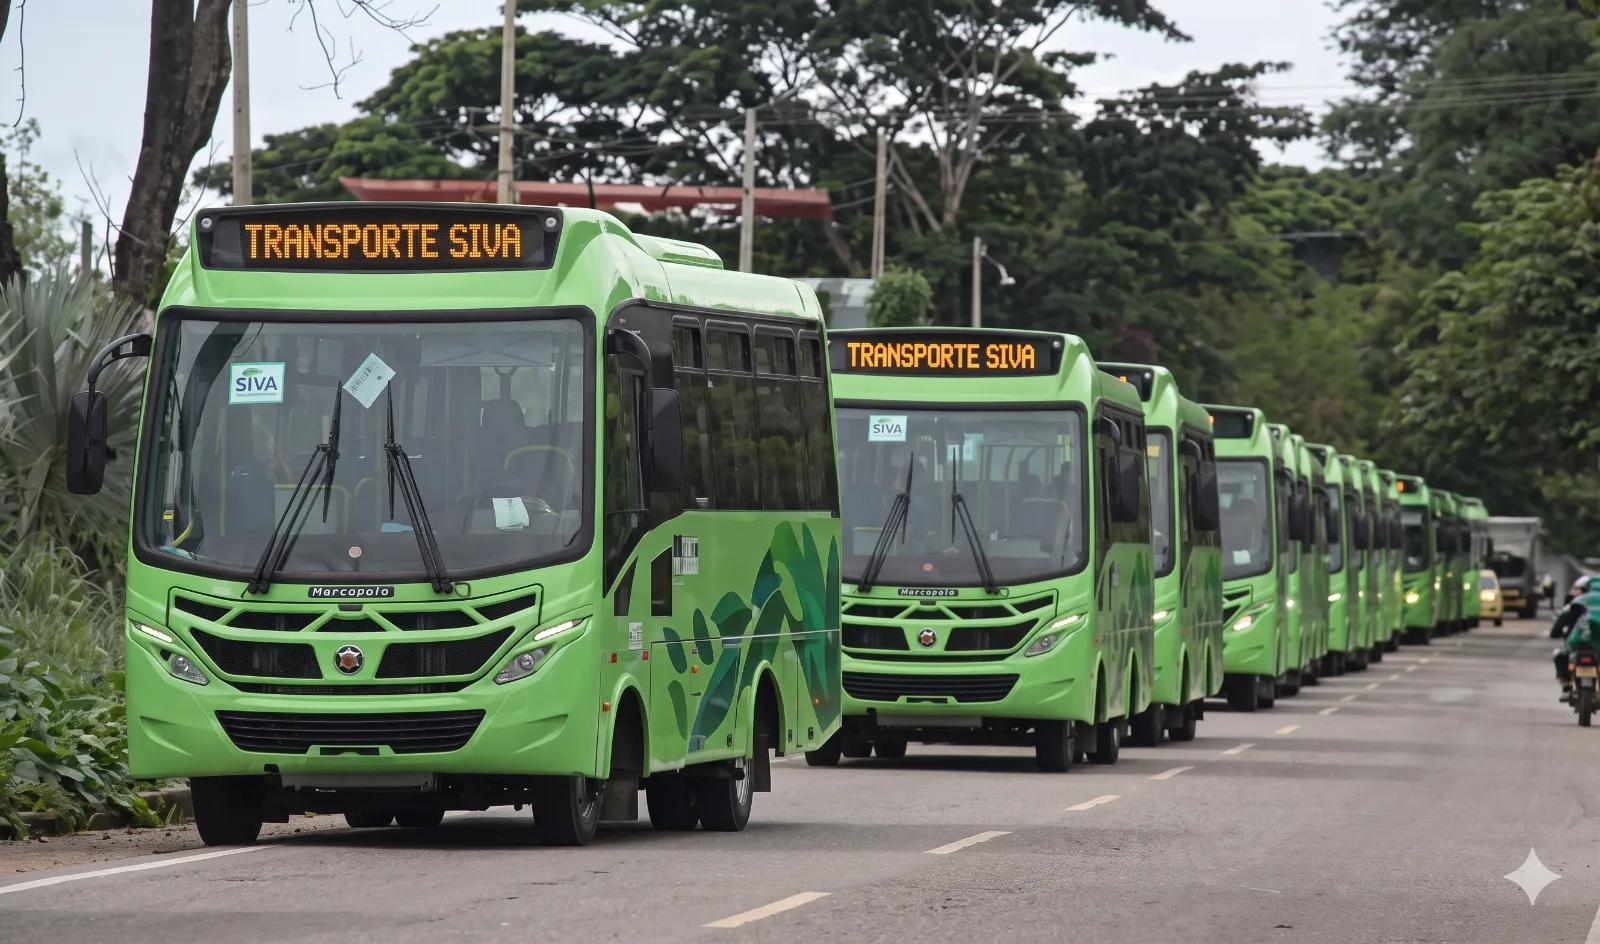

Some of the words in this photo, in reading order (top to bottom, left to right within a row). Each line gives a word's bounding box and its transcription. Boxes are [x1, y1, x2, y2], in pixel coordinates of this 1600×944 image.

[244, 223, 439, 259] TRANSPORTE
[449, 223, 521, 258] SIVA
[847, 342, 980, 369] TRANSPORTE
[986, 343, 1035, 369] SIVA
[235, 376, 278, 392] SIVA
[873, 423, 903, 434] SIVA
[312, 586, 389, 598] Marcopolo
[900, 588, 955, 597] Marcopolo
